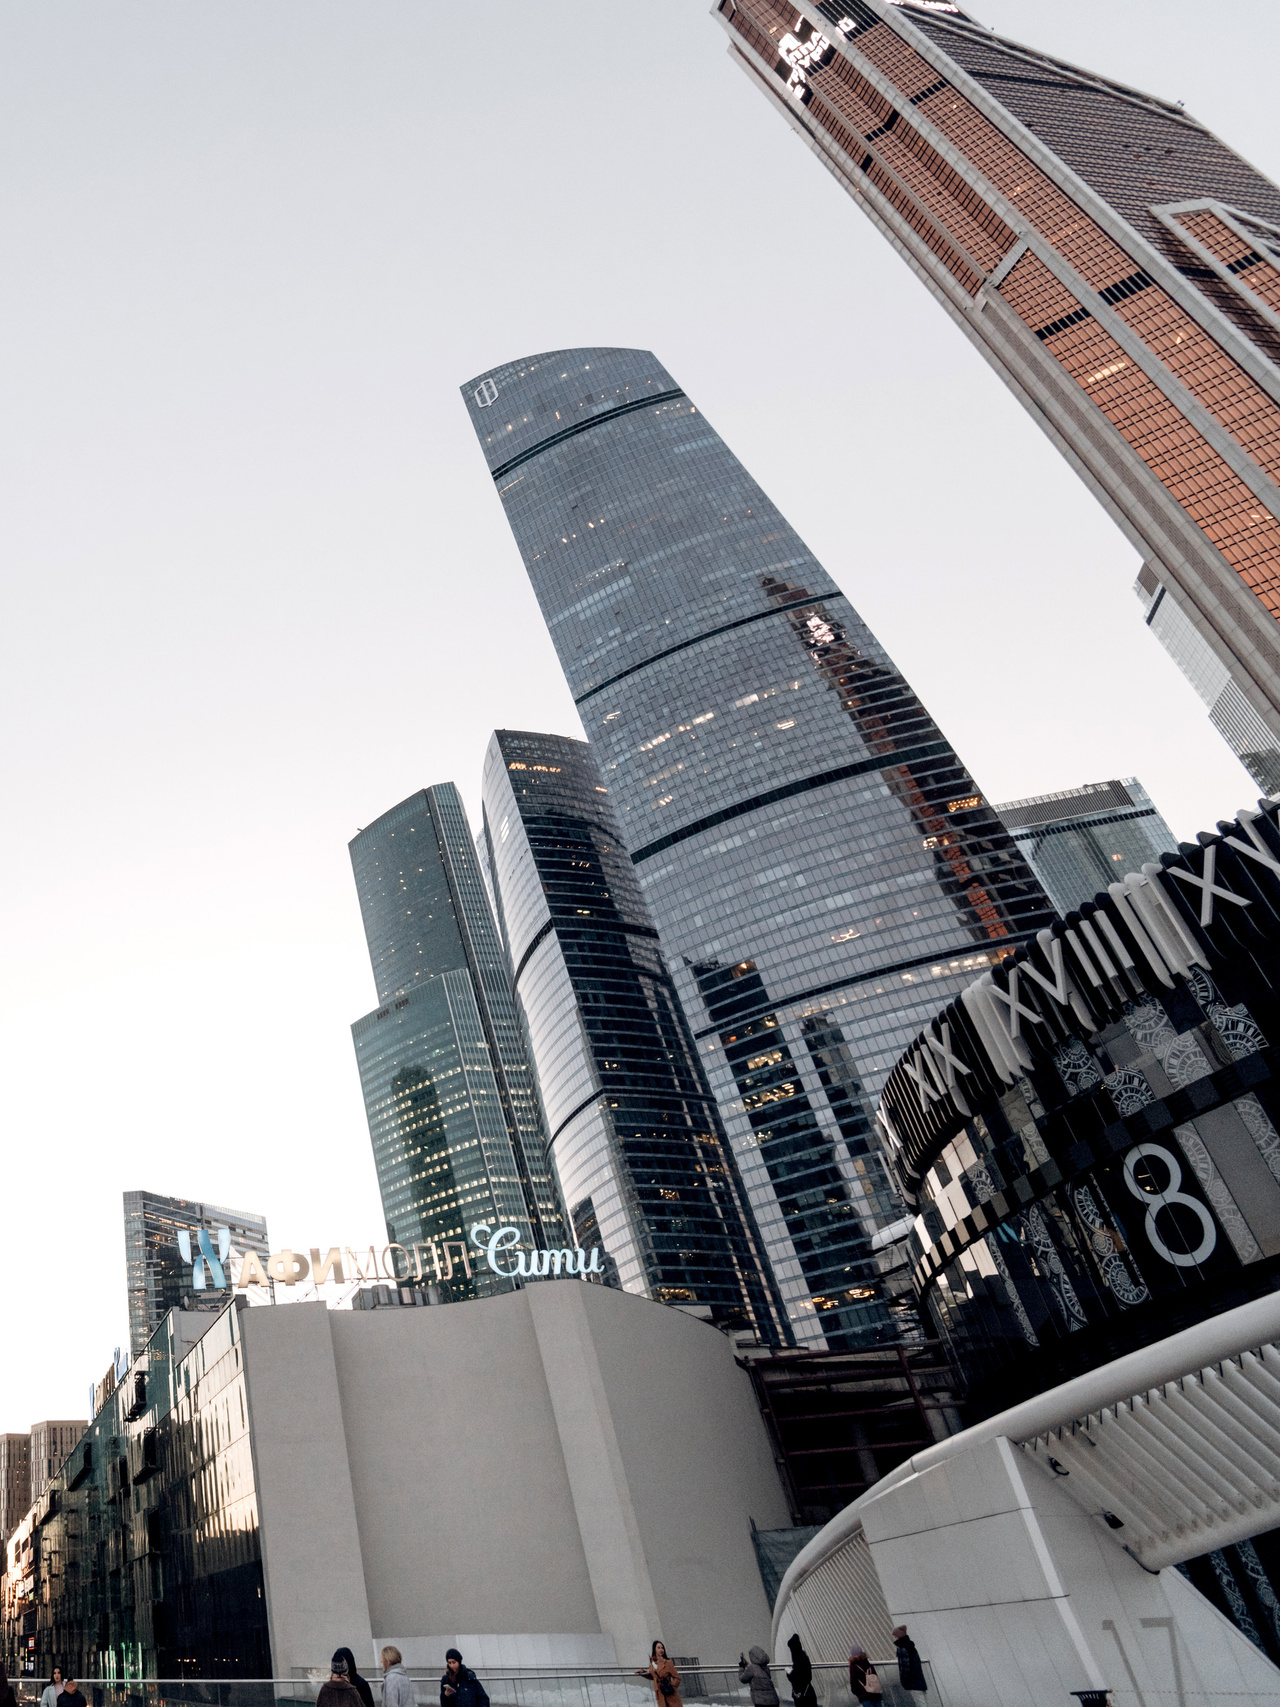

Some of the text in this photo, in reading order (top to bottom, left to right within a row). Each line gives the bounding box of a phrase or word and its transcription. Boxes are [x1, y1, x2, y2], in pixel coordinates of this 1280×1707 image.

[1123, 1143, 1217, 1267] 8
[238, 1224, 606, 1288] АФИМОЛЛ Сити
